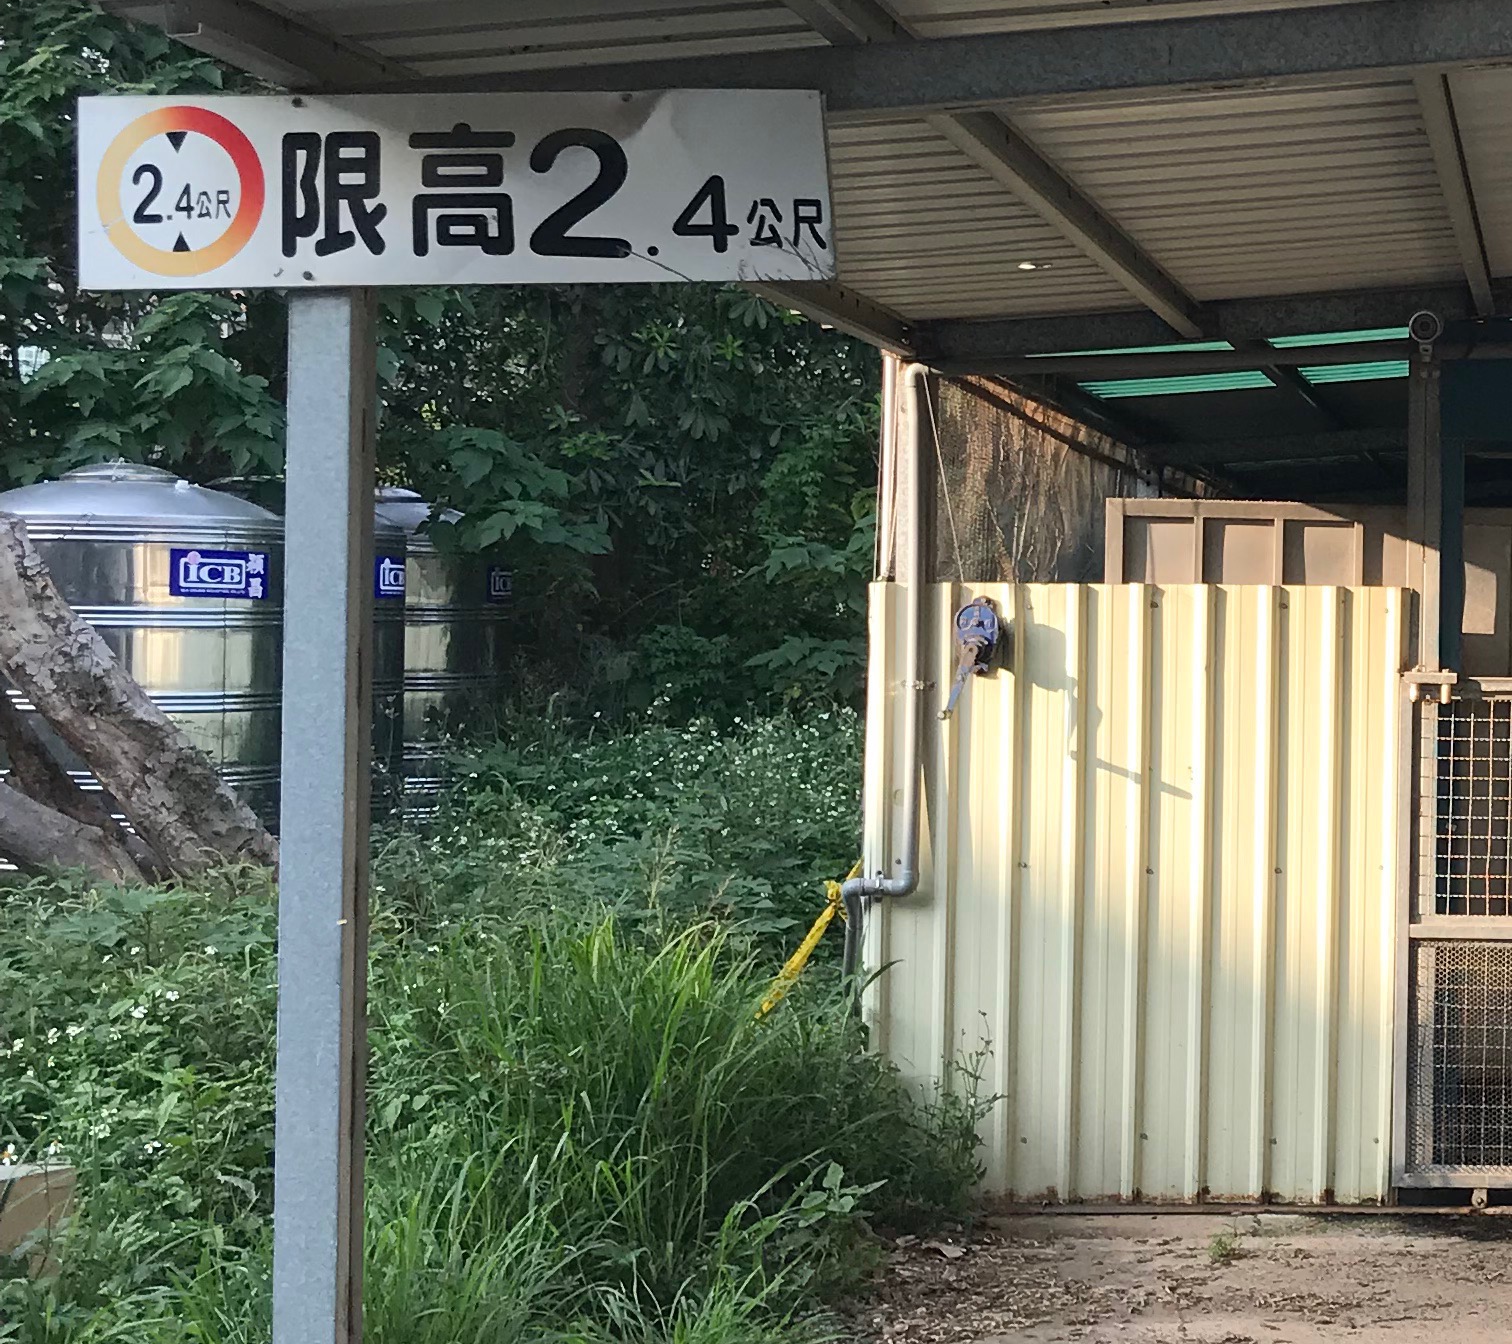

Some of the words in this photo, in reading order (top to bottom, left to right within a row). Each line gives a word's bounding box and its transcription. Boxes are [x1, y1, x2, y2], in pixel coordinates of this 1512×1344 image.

[132, 163, 231, 224] 2.4公尺
[281, 122, 828, 258] 限高2.4公尺
